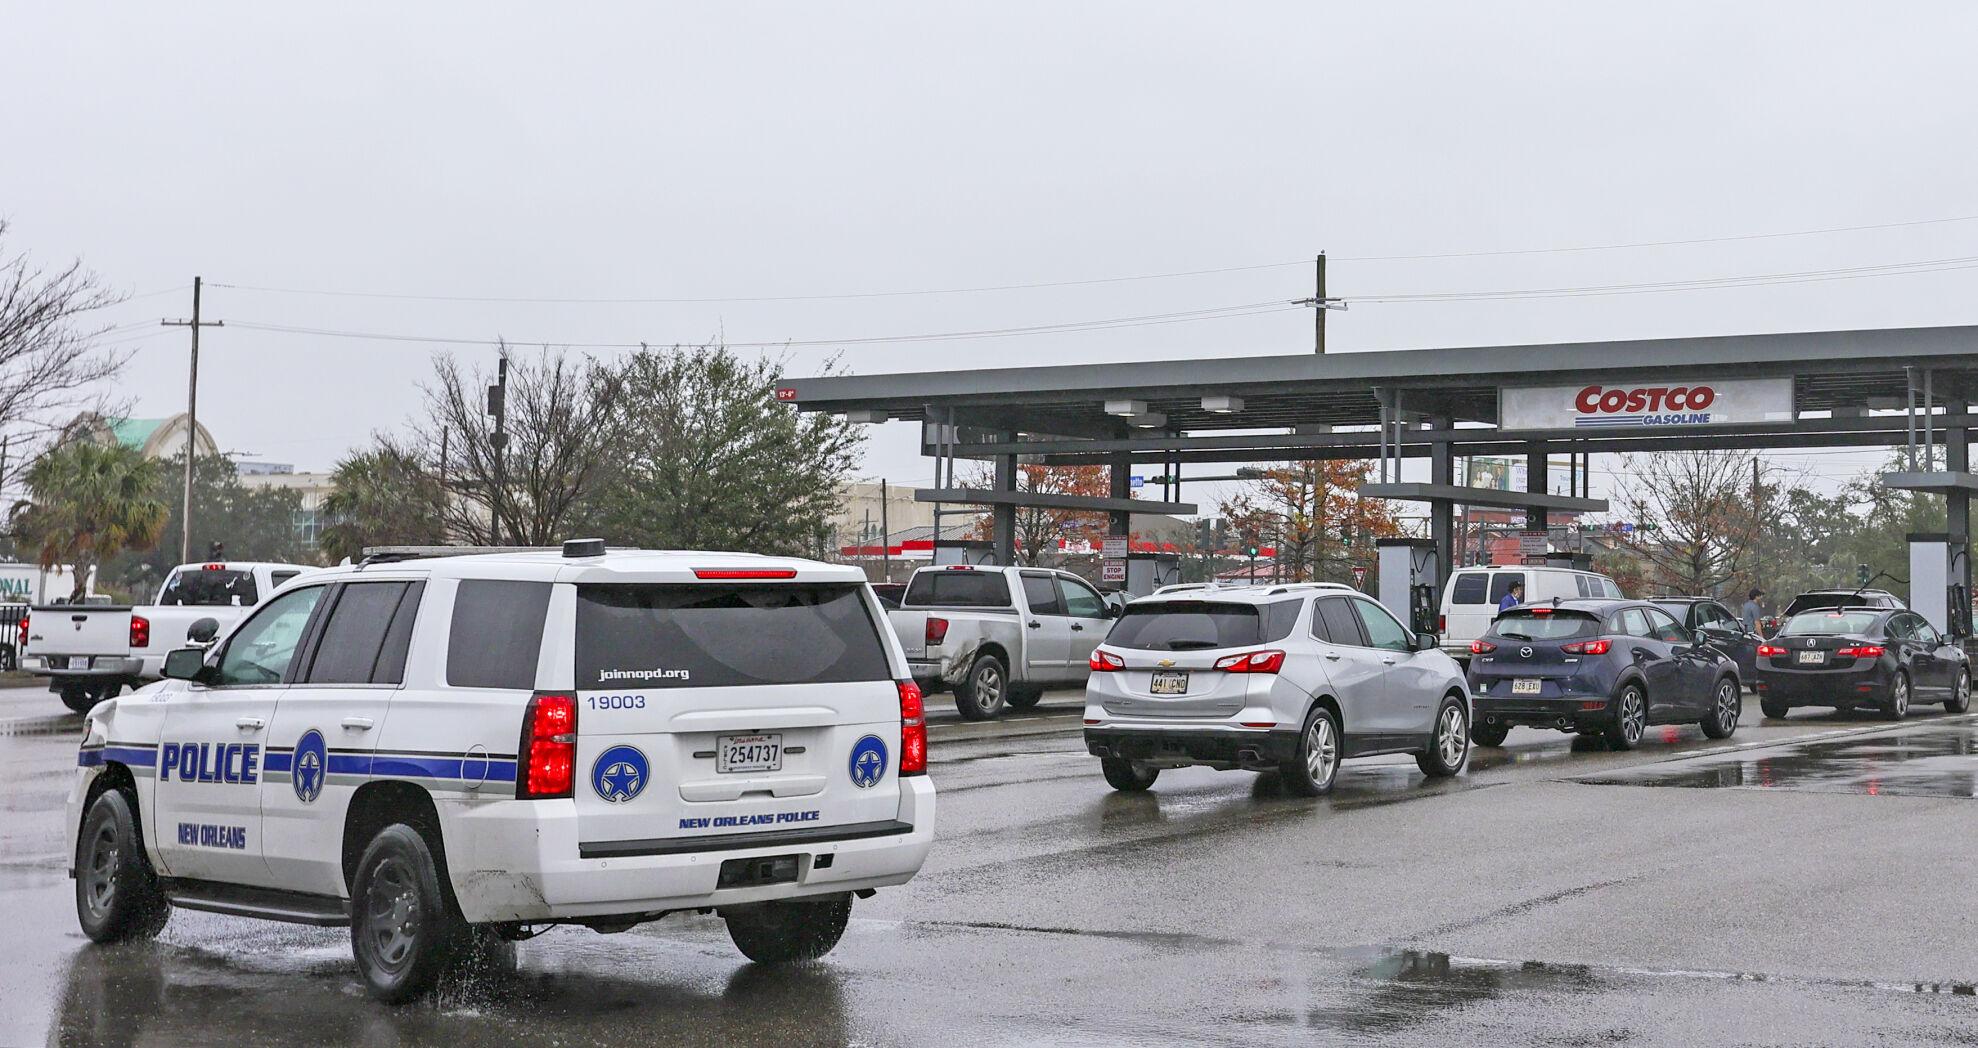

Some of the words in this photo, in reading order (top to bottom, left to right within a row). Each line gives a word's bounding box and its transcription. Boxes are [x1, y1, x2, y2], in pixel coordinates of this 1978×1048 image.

[1575, 385, 1715, 414] COSTCO
[1643, 413, 1711, 425] GASOLINE
[598, 668, 690, 682] joinnopd.org
[587, 695, 646, 710] 19003
[160, 742, 260, 785] POLICE
[730, 744, 779, 764] 254737
[679, 818, 711, 829] NEW
[713, 814, 774, 827] ORLEANS
[776, 810, 820, 824] POLICE
[178, 822, 200, 846] NEW
[200, 824, 246, 850] ORLEANS
